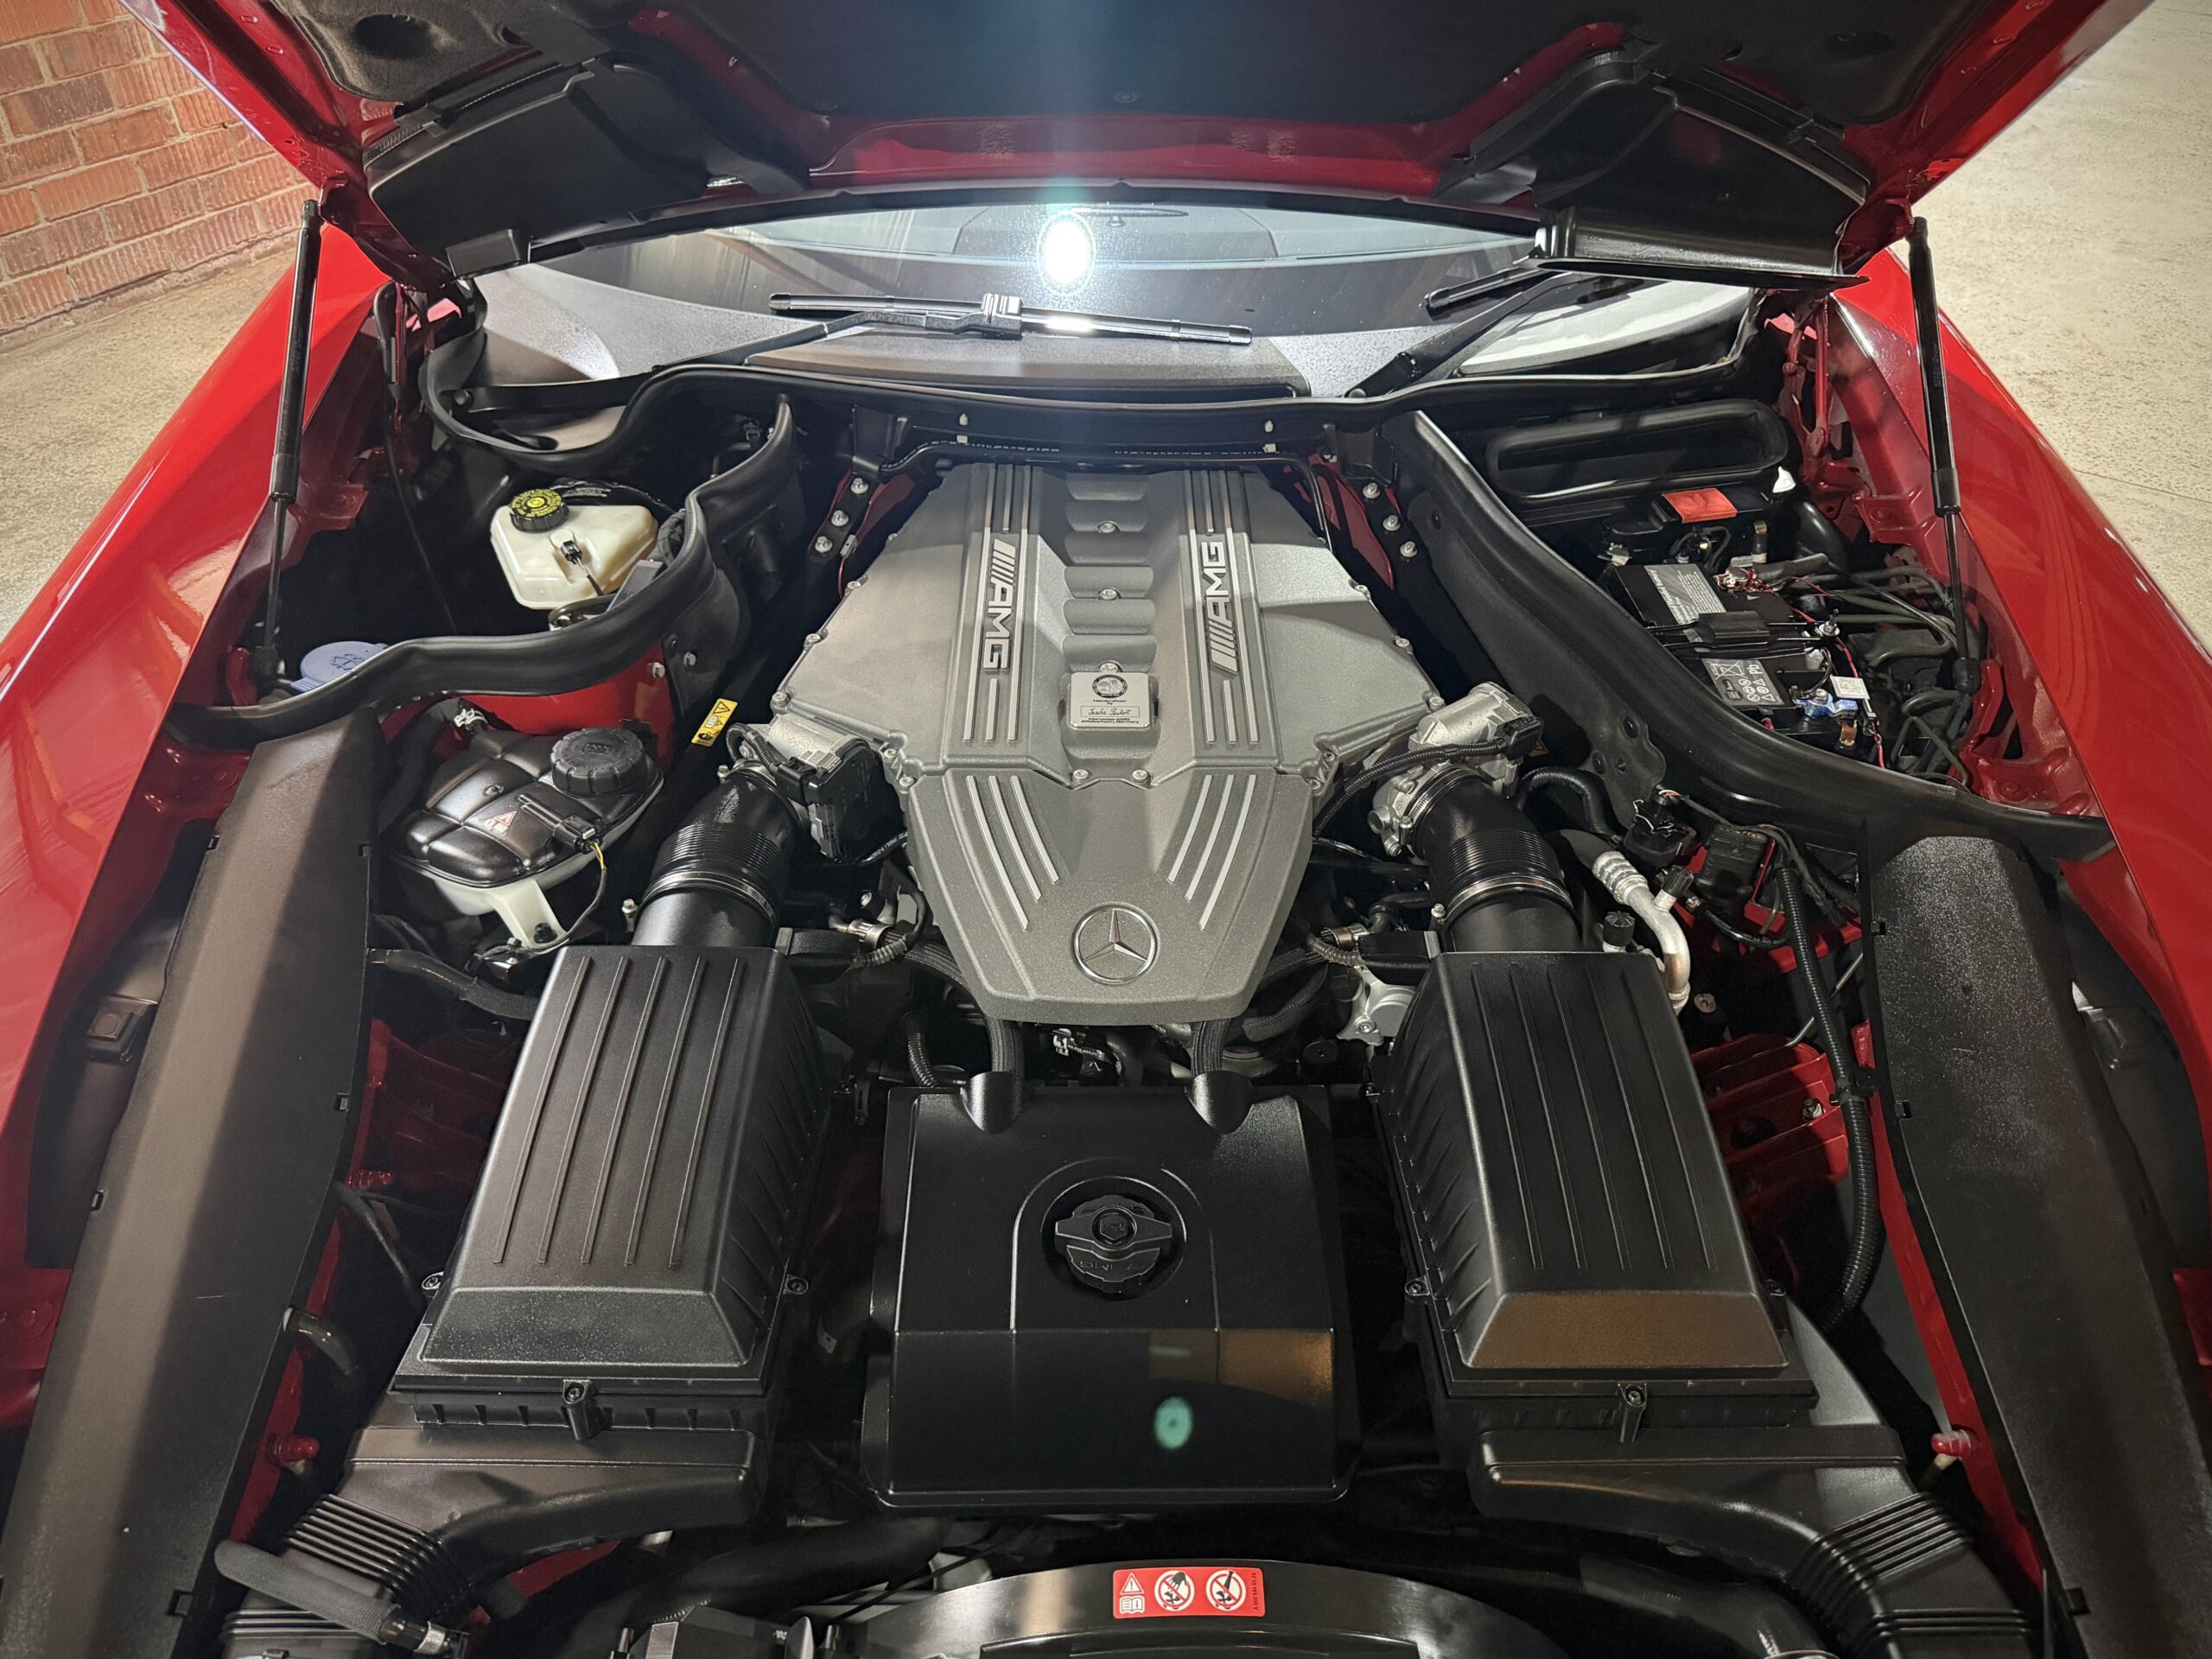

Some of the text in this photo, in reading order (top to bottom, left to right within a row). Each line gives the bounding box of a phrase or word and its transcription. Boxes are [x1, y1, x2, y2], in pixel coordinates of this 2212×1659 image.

[983, 577, 1014, 669] AMG
[1201, 542, 1232, 627] AMG
[1746, 664, 1764, 675] Pb
